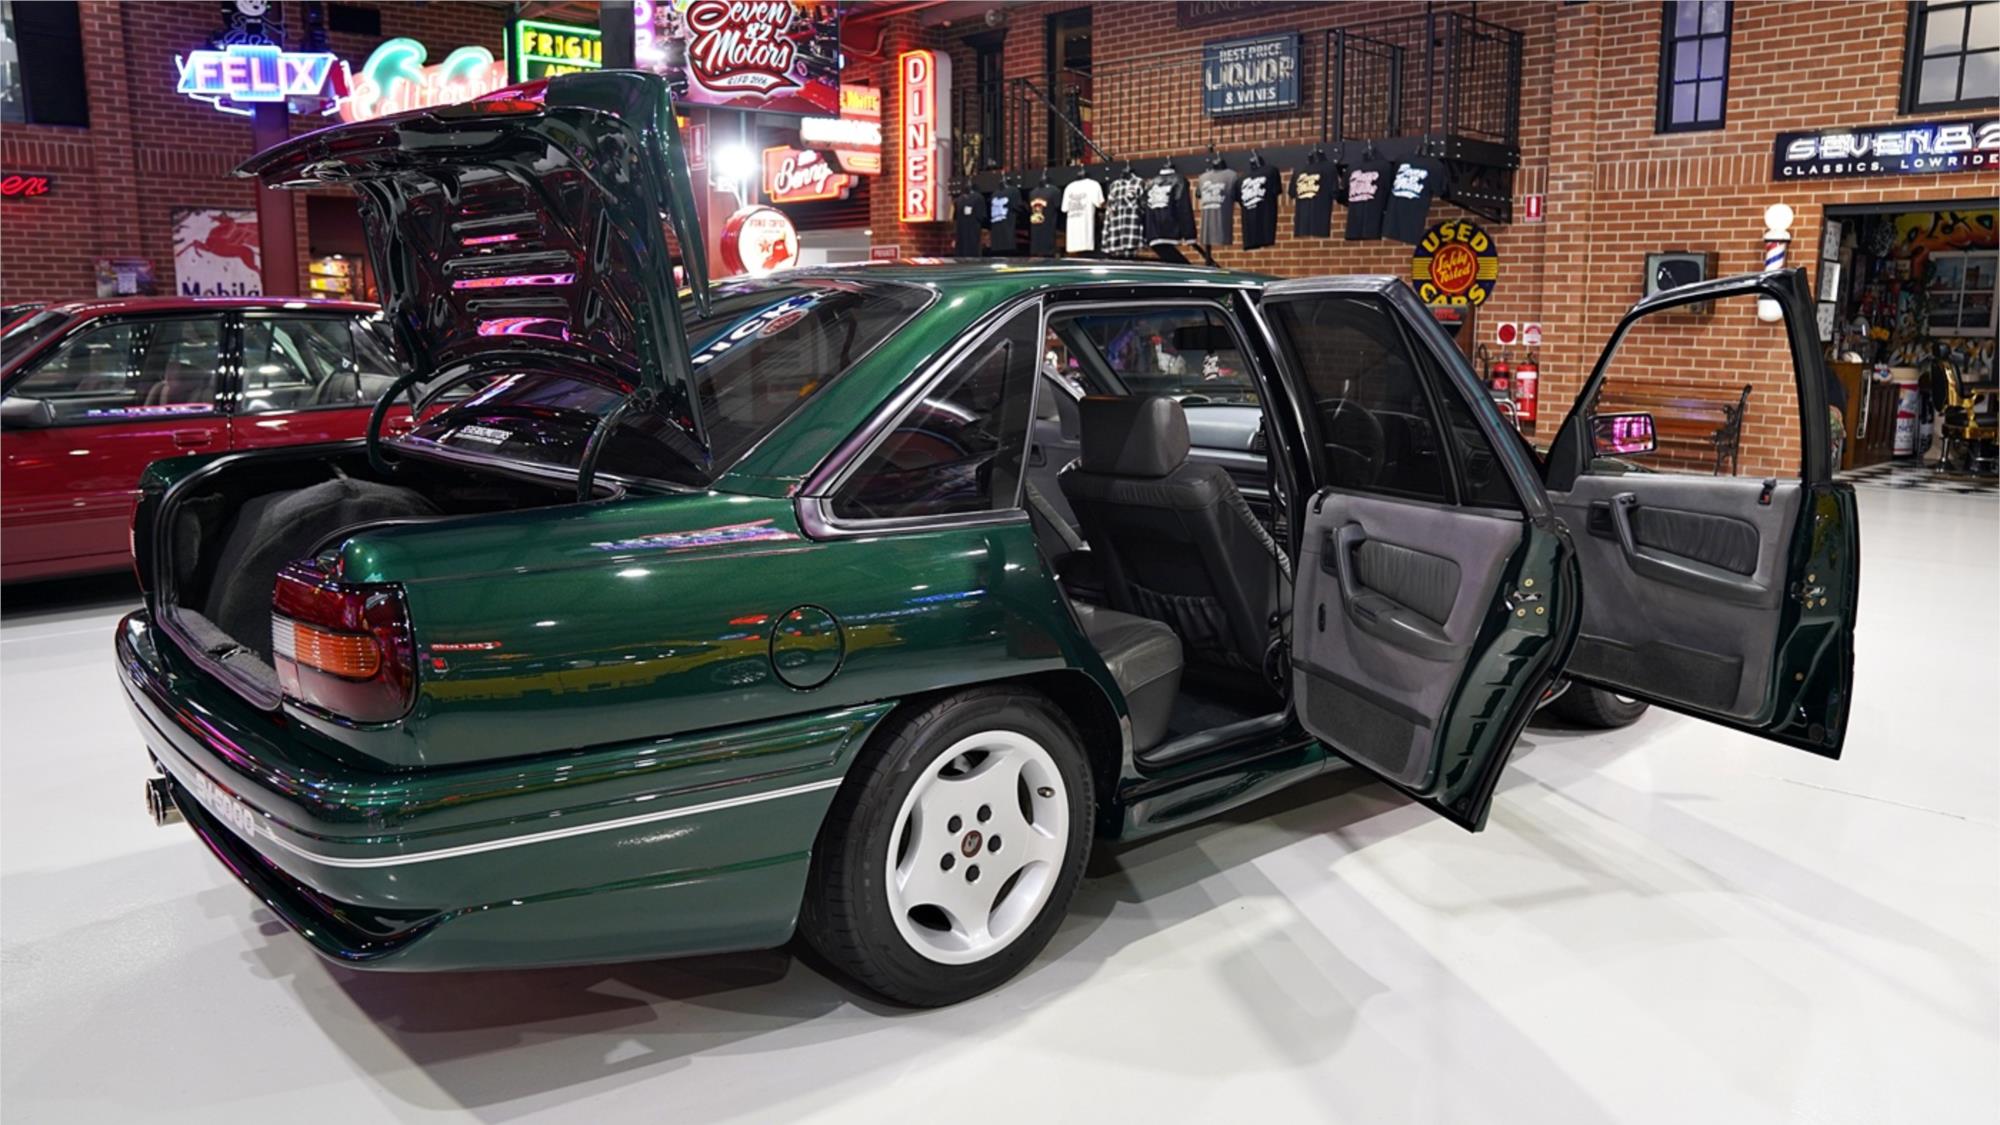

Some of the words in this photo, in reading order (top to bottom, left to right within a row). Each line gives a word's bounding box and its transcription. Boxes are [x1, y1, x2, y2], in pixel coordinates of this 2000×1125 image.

[691, 1, 786, 31] Seven
[745, 23, 773, 41] 82
[695, 30, 790, 73] Motors
[1220, 47, 1246, 63] BEST
[1249, 43, 1283, 58] PRICE
[196, 57, 318, 91] FELIX
[1206, 56, 1294, 90] LIQUOR
[1225, 92, 1234, 104] &
[1237, 87, 1277, 102] WINES
[908, 57, 928, 215] DINER
[1783, 161, 1884, 176] CLASSICS,
[1422, 222, 1489, 253] USED
